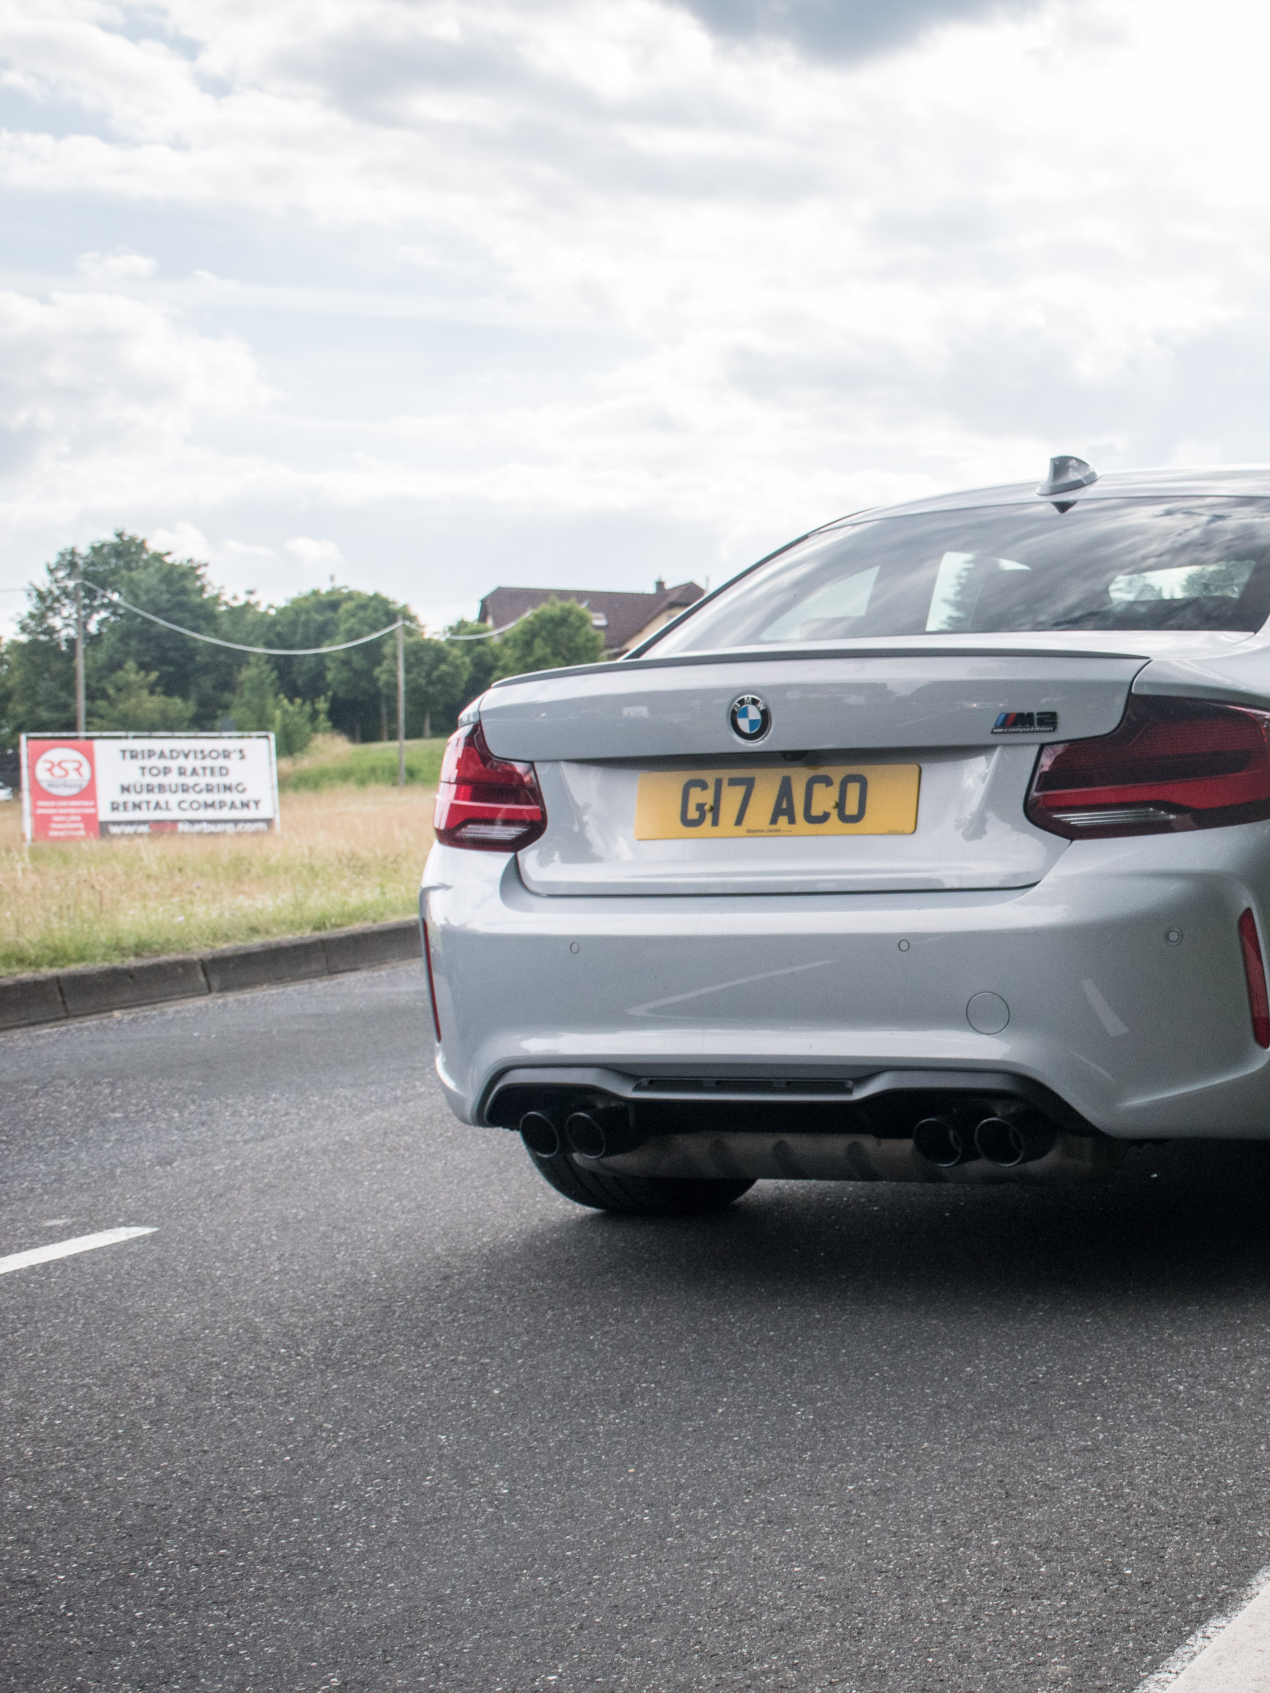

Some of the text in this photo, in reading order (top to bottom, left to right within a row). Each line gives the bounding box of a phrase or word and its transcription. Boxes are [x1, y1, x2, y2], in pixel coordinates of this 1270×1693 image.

[733, 696, 766, 712] BMW
[120, 748, 246, 761] TRIPADVISOR'S
[42, 759, 84, 778] RSR
[139, 765, 230, 778] TOP RATED
[120, 781, 247, 795] NÜRBURGRING
[110, 800, 172, 813] RENTAL
[177, 799, 262, 812] COMPANY
[680, 774, 869, 828] G17 ACO
